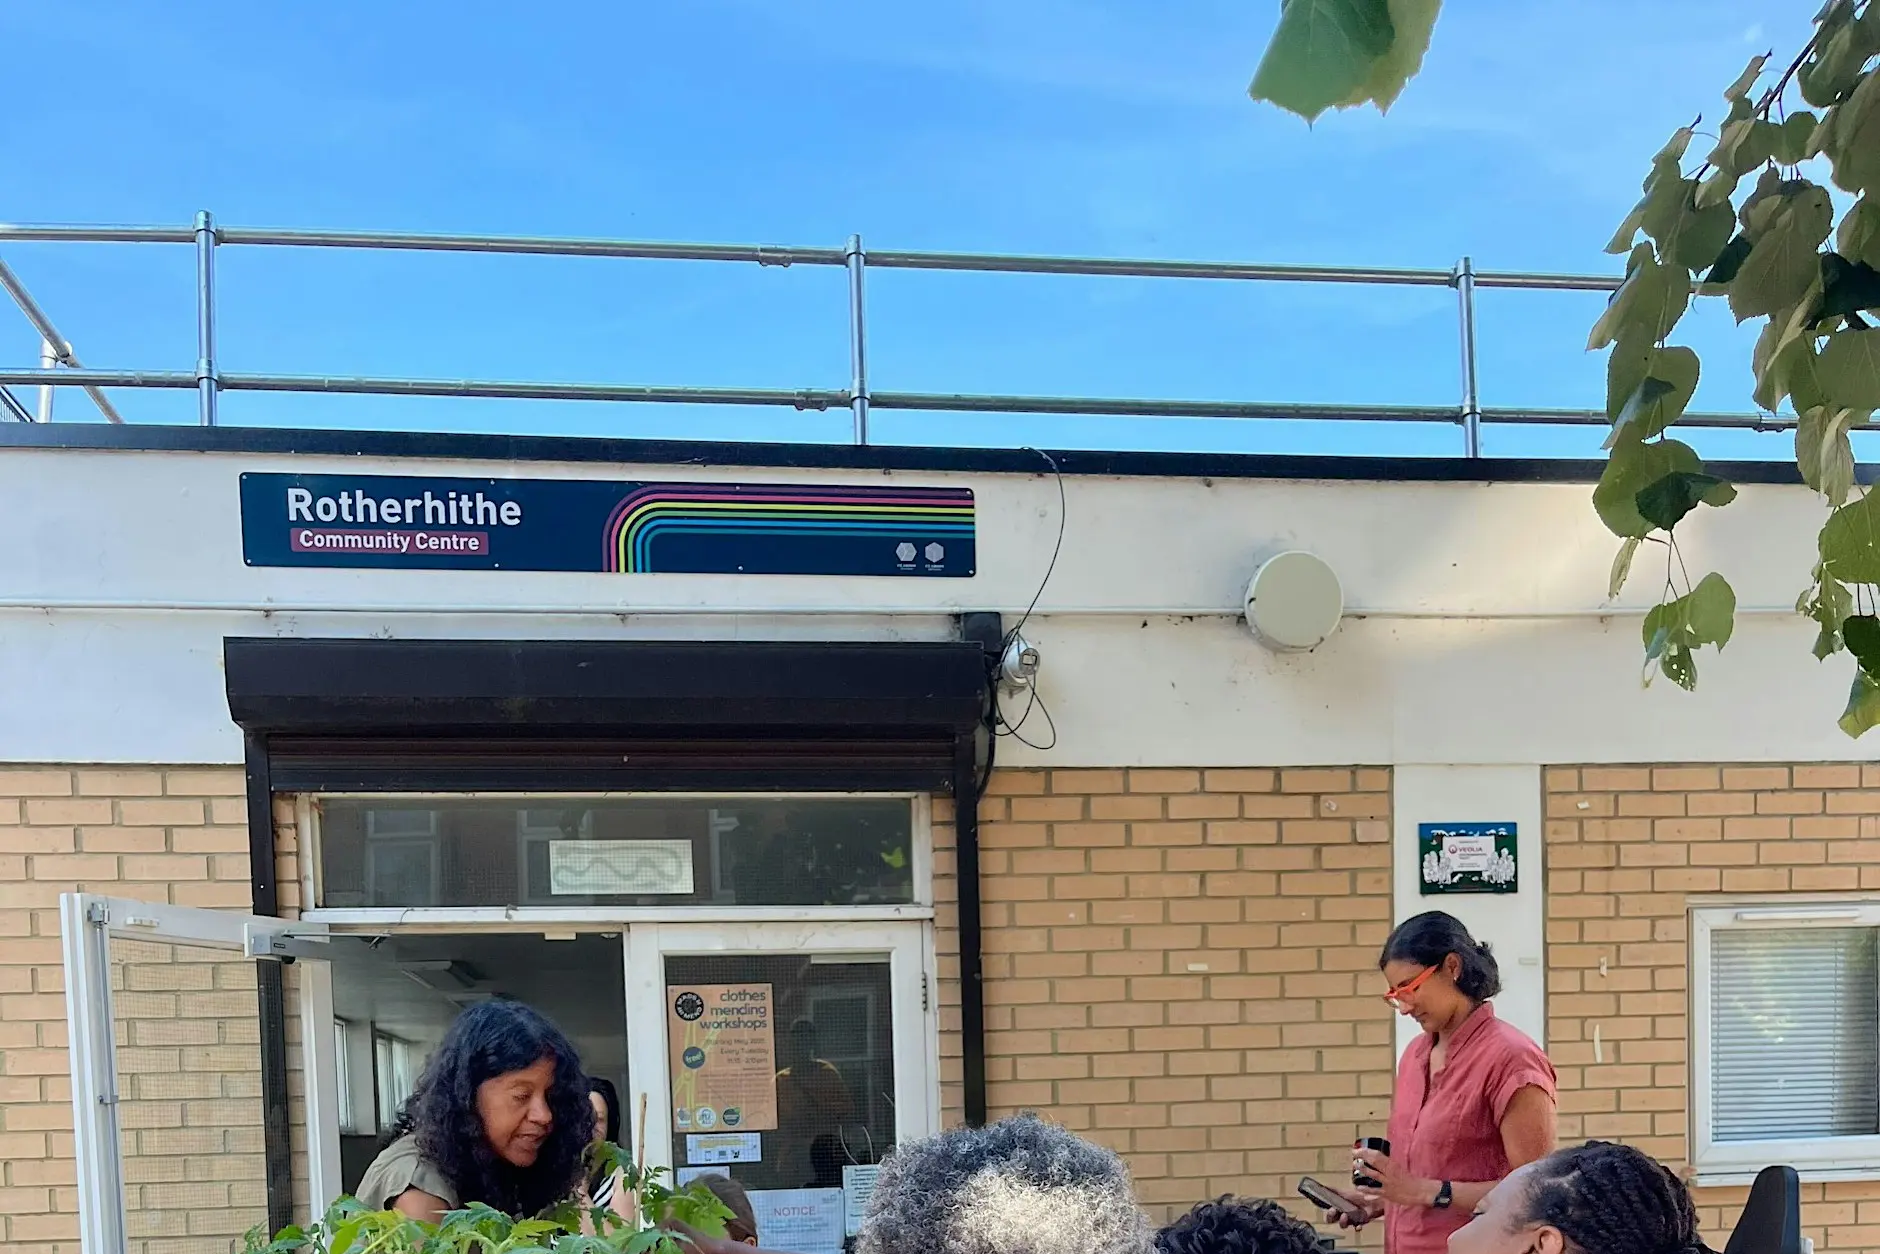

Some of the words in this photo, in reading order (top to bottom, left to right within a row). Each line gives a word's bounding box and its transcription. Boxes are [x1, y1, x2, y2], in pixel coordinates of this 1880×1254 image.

[287, 487, 522, 526] Rotherhithe
[299, 529, 411, 553] Community
[415, 532, 480, 551] Centre
[720, 988, 766, 1002] clothes
[710, 1003, 767, 1018] mending
[700, 1016, 768, 1031] workshops
[773, 1205, 816, 1217] NOTICE
